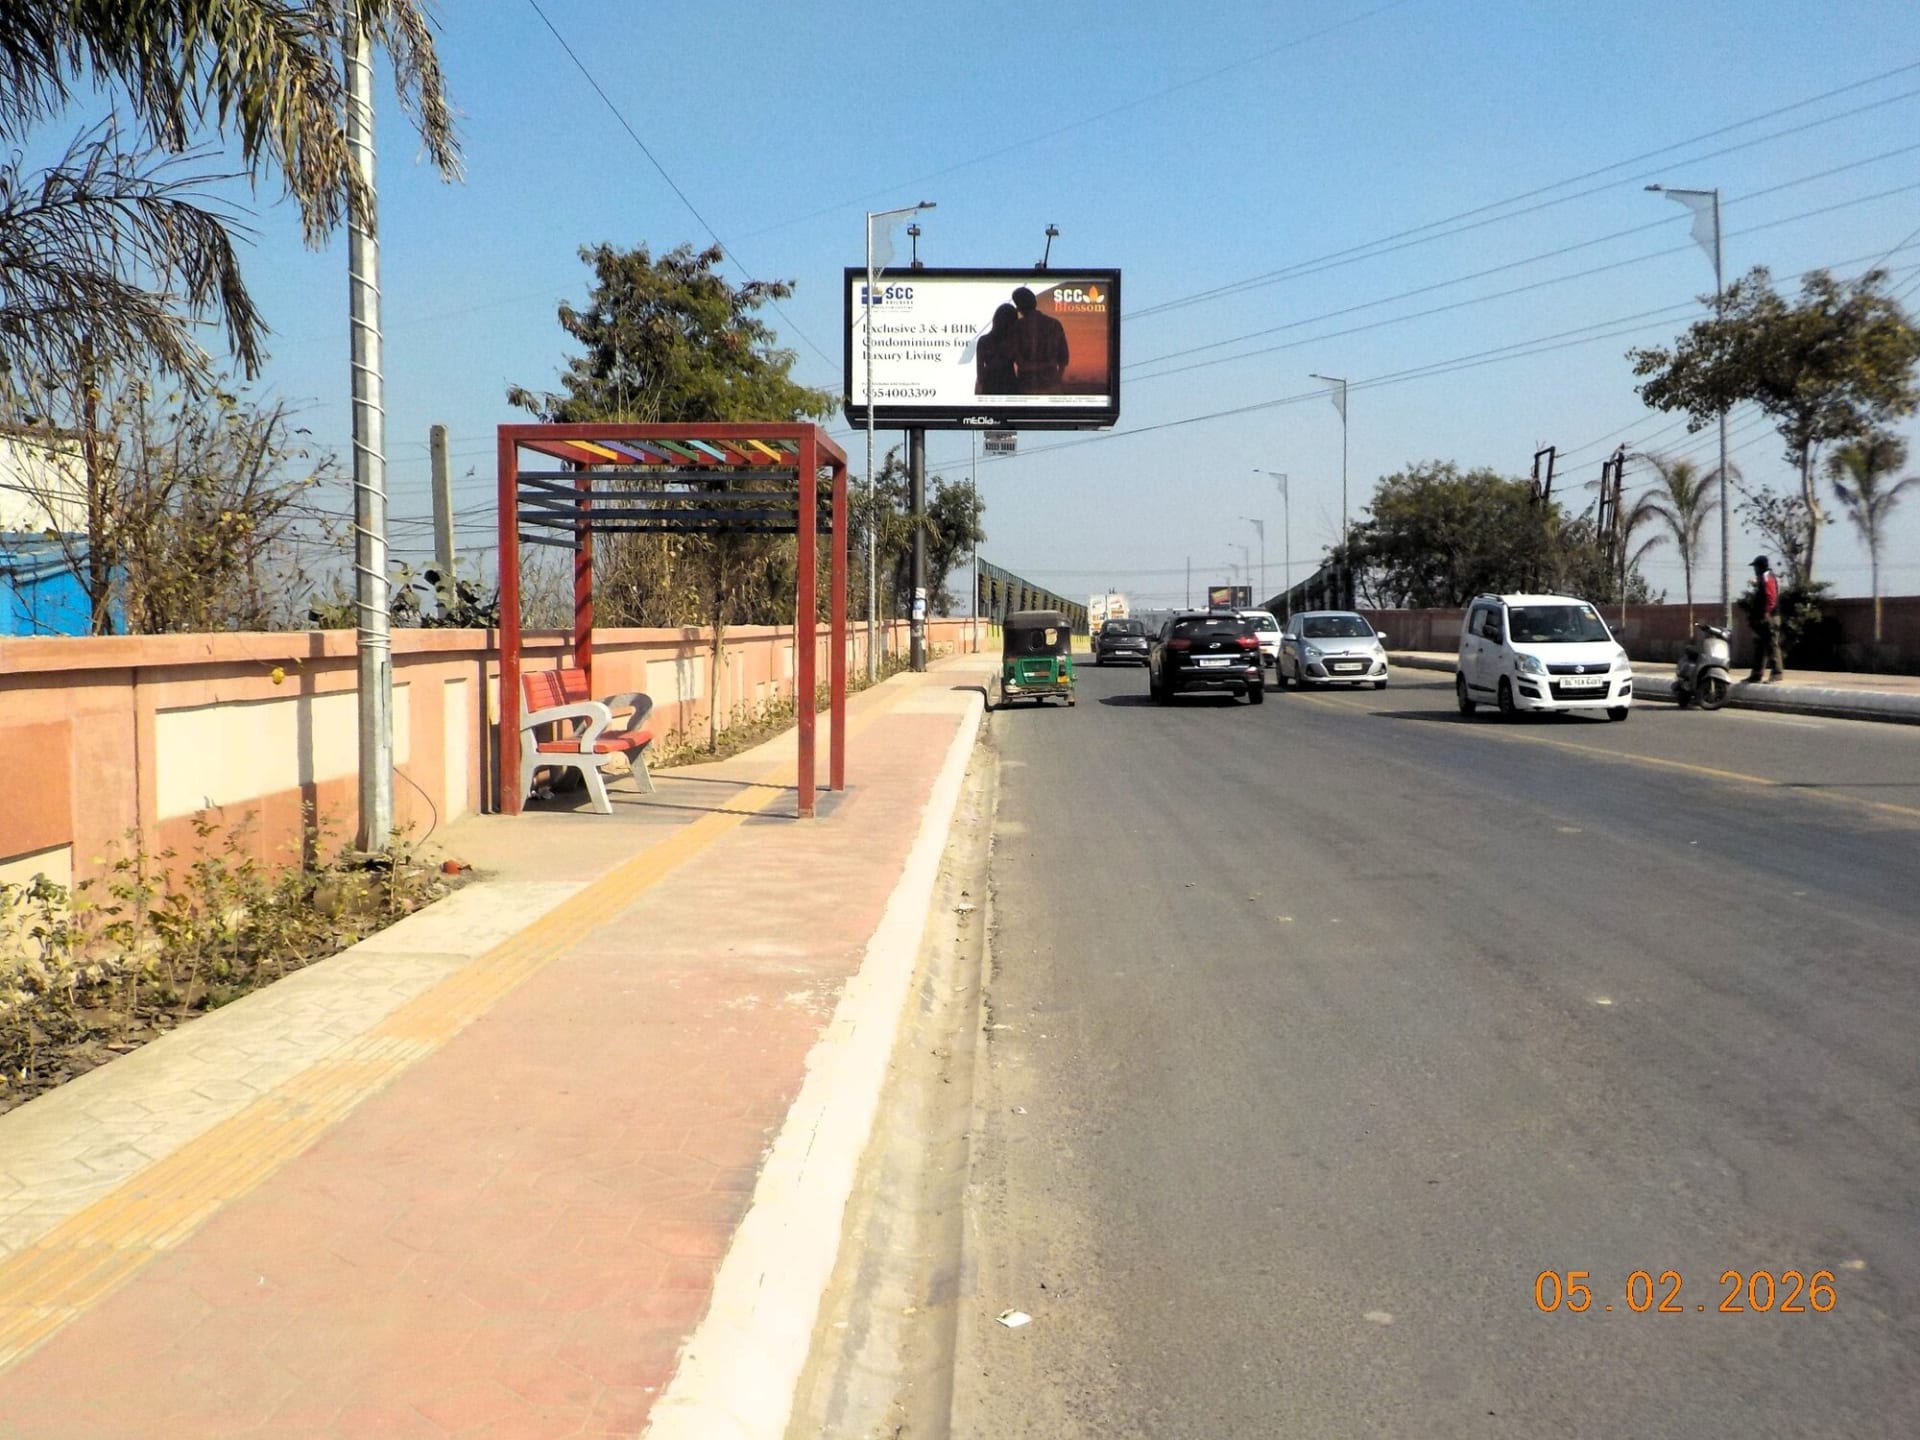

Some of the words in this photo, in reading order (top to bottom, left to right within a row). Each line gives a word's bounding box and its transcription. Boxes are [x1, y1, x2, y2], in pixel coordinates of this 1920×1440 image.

[886, 287, 914, 299] SCC
[1053, 289, 1083, 303] SCC
[1055, 303, 1106, 312] Blossom
[919, 323, 926, 334] 3
[929, 324, 938, 334] &
[941, 324, 948, 334] 4
[951, 324, 978, 334] BHK
[862, 337, 951, 348] Condominiums
[954, 337, 970, 348] for
[906, 350, 942, 362] Living
